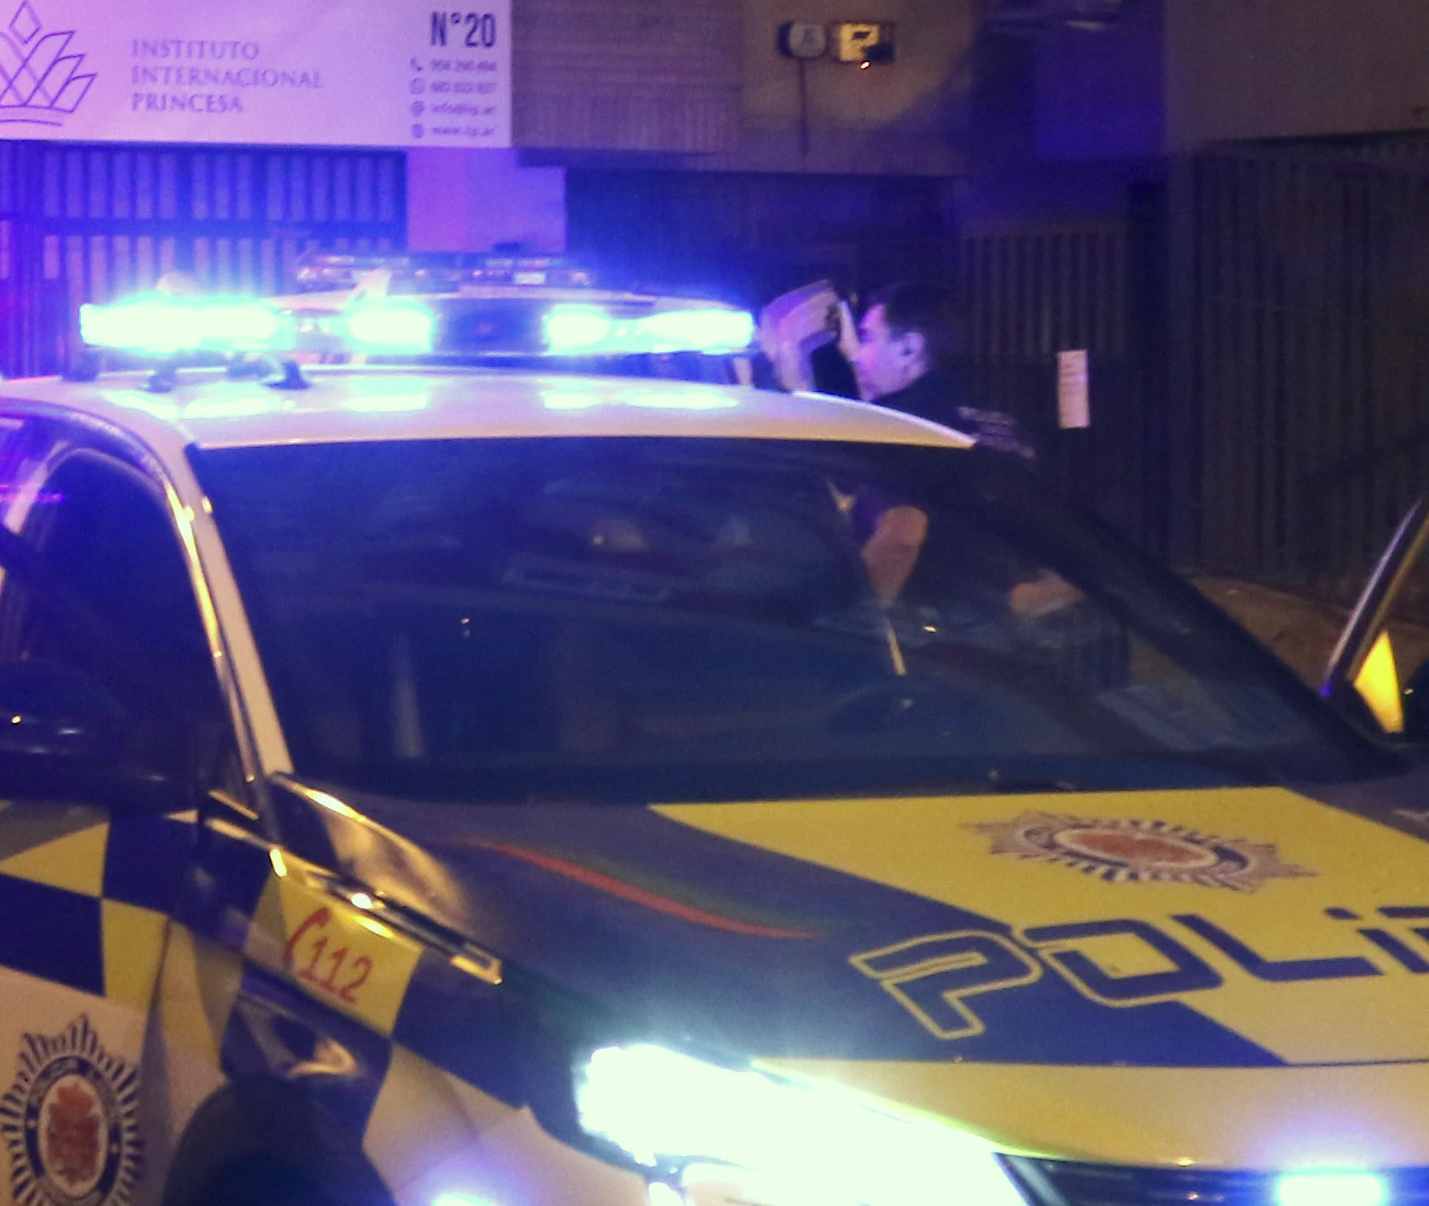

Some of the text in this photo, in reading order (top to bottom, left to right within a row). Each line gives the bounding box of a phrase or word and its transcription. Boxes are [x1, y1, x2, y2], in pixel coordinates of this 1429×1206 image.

[131, 38, 260, 60] INSTITUTO
[131, 65, 325, 89] INTERNACIONAL
[131, 92, 244, 113] PRINCESA
[297, 938, 373, 1003] 112
